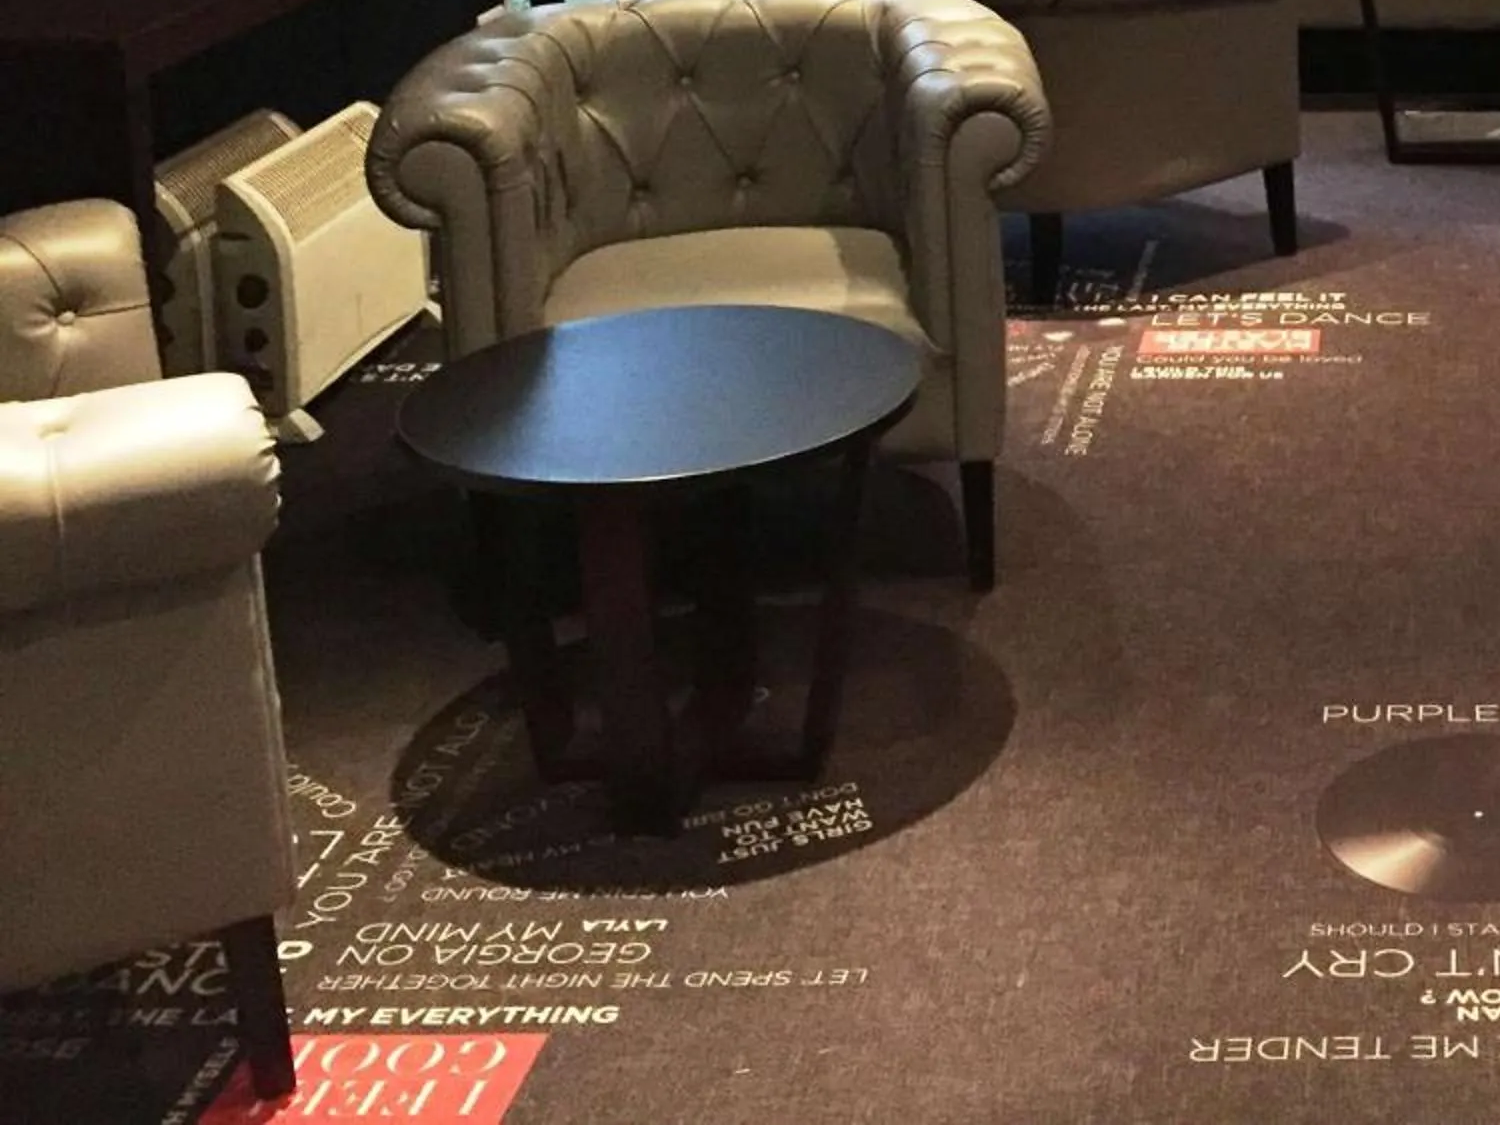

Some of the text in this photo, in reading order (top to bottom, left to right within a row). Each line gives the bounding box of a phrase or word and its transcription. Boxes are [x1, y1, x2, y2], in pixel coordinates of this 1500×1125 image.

[1168, 292, 1347, 303] CAN FEEL IT
[1219, 302, 1346, 311] EVERYTHING
[1151, 311, 1431, 326] LET'S DANCE
[1322, 703, 1500, 724] PURPLE
[785, 796, 864, 823] HAVE
[720, 815, 780, 839] FUN
[735, 808, 870, 847] WANT TO
[717, 819, 874, 865] GIRLS JUST
[294, 872, 368, 929] YOU
[341, 814, 406, 868] ARE
[354, 921, 563, 943] MY MIND
[580, 918, 670, 933] LAYLA
[1309, 921, 1424, 937] SHOULD
[335, 941, 652, 966] GEORGIA ON
[1282, 947, 1415, 979] CRY
[316, 970, 793, 991] SPEND THE NIGHT TOGETHER
[303, 1006, 621, 1026] MY EVERYTHING
[1189, 1036, 1393, 1063] TENDER
[1410, 1034, 1479, 1060] ME
[290, 1078, 490, 1117] I FEE
